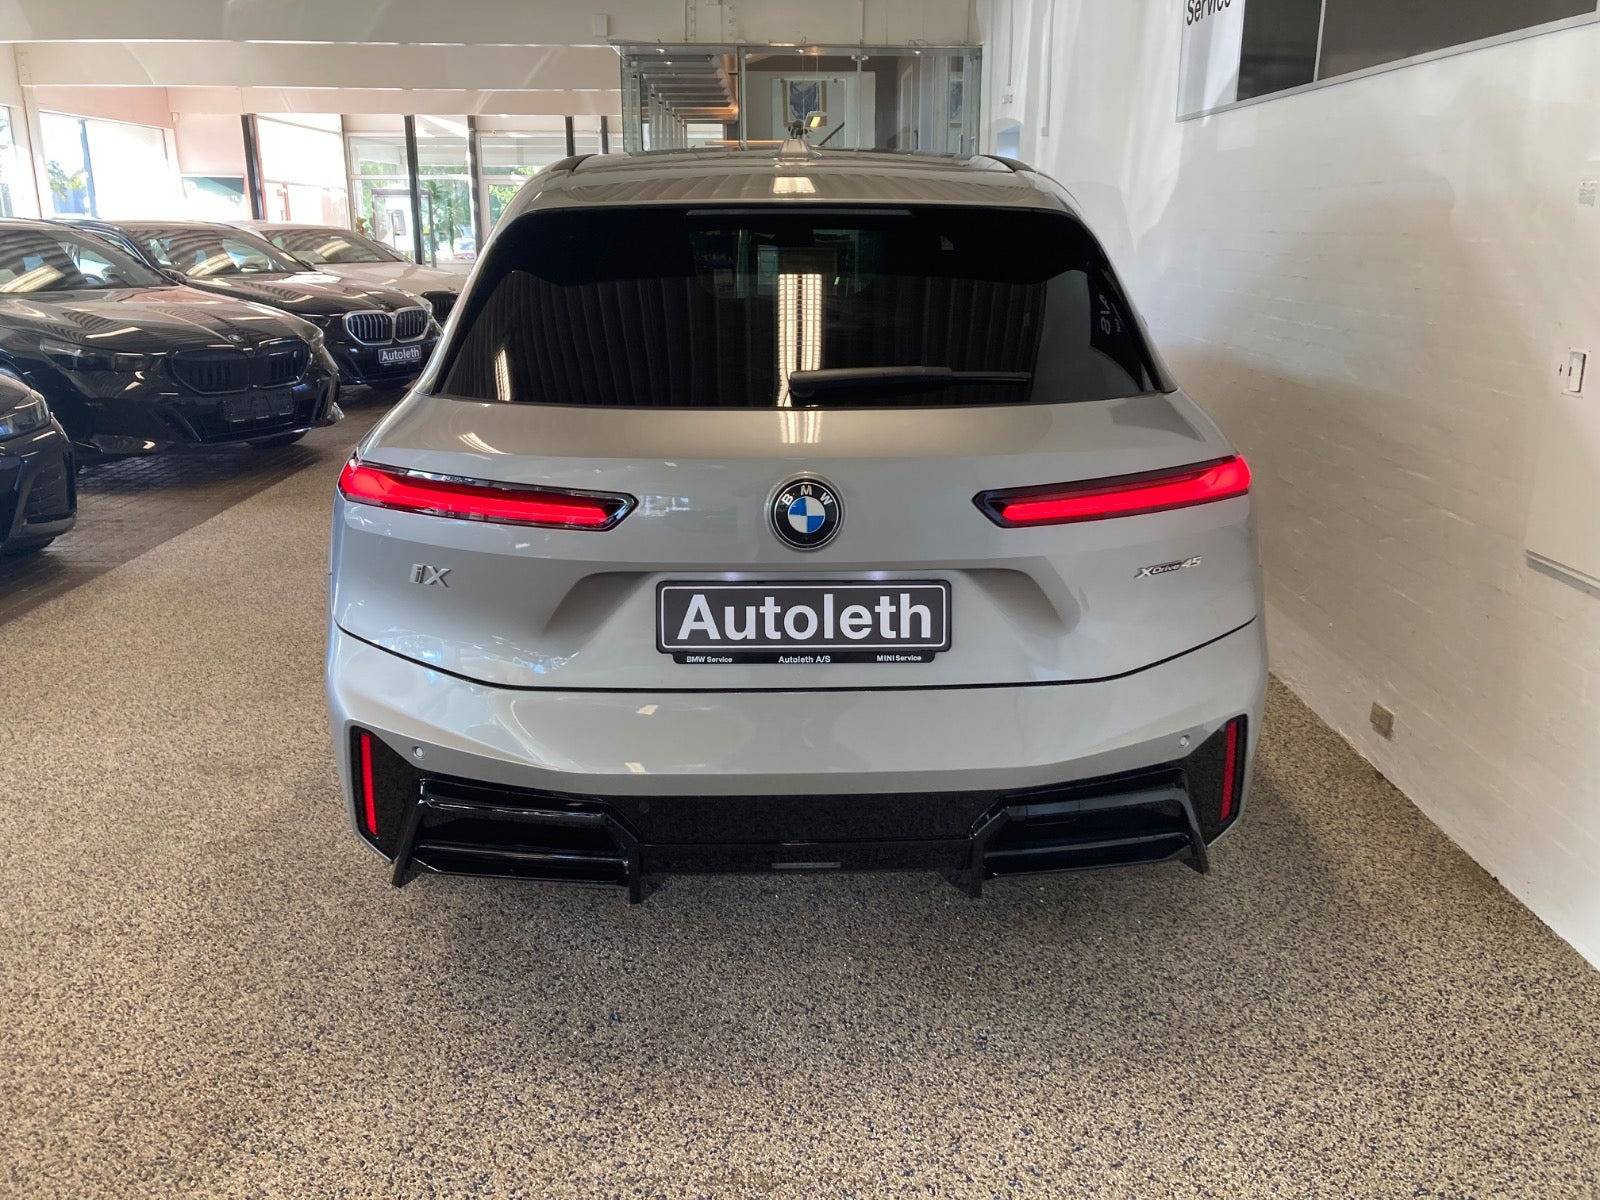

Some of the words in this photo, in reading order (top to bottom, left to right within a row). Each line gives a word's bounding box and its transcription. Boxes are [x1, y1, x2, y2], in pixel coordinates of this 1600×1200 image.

[382, 347, 420, 362] Autoleth
[781, 485, 833, 506] BMW
[676, 593, 932, 641] Autoleth
[686, 655, 705, 663] BMW
[706, 655, 733, 663] Service
[778, 655, 814, 663] Autoleth
[815, 655, 831, 663] A/S
[876, 654, 895, 662] MINI
[895, 654, 922, 662] Service
